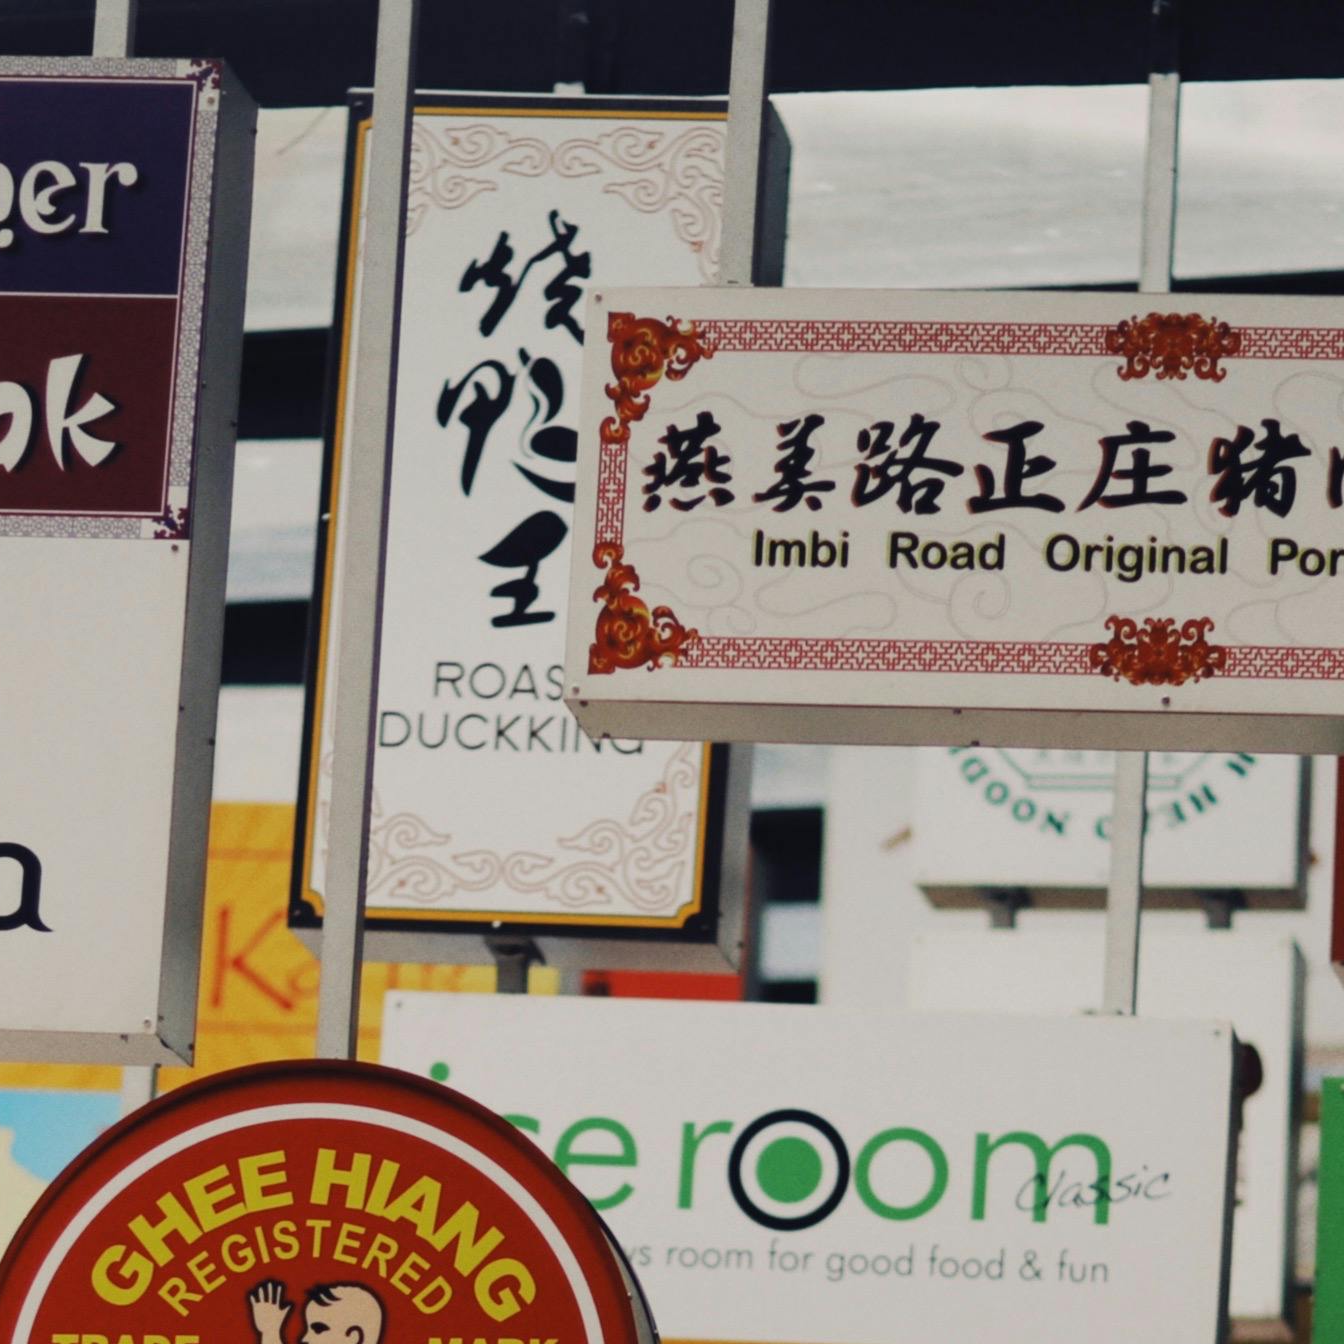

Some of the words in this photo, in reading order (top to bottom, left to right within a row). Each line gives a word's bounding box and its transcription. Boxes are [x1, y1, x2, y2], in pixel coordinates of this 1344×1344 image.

[752, 529, 851, 569] Imbi
[887, 531, 1006, 572] Road
[1045, 534, 1229, 582] Original
[433, 660, 565, 702] ROAS
[677, 1108, 1113, 1231] room
[90, 1149, 294, 1307] GHEE
[309, 1148, 538, 1323] HIANG
[157, 1218, 455, 1318] REGISTERED
[665, 1243, 753, 1272] room
[768, 1238, 813, 1273] for
[826, 1244, 913, 1282] good
[929, 1243, 1005, 1281] food
[1018, 1249, 1043, 1281] &
[1056, 1252, 1110, 1284] fun
